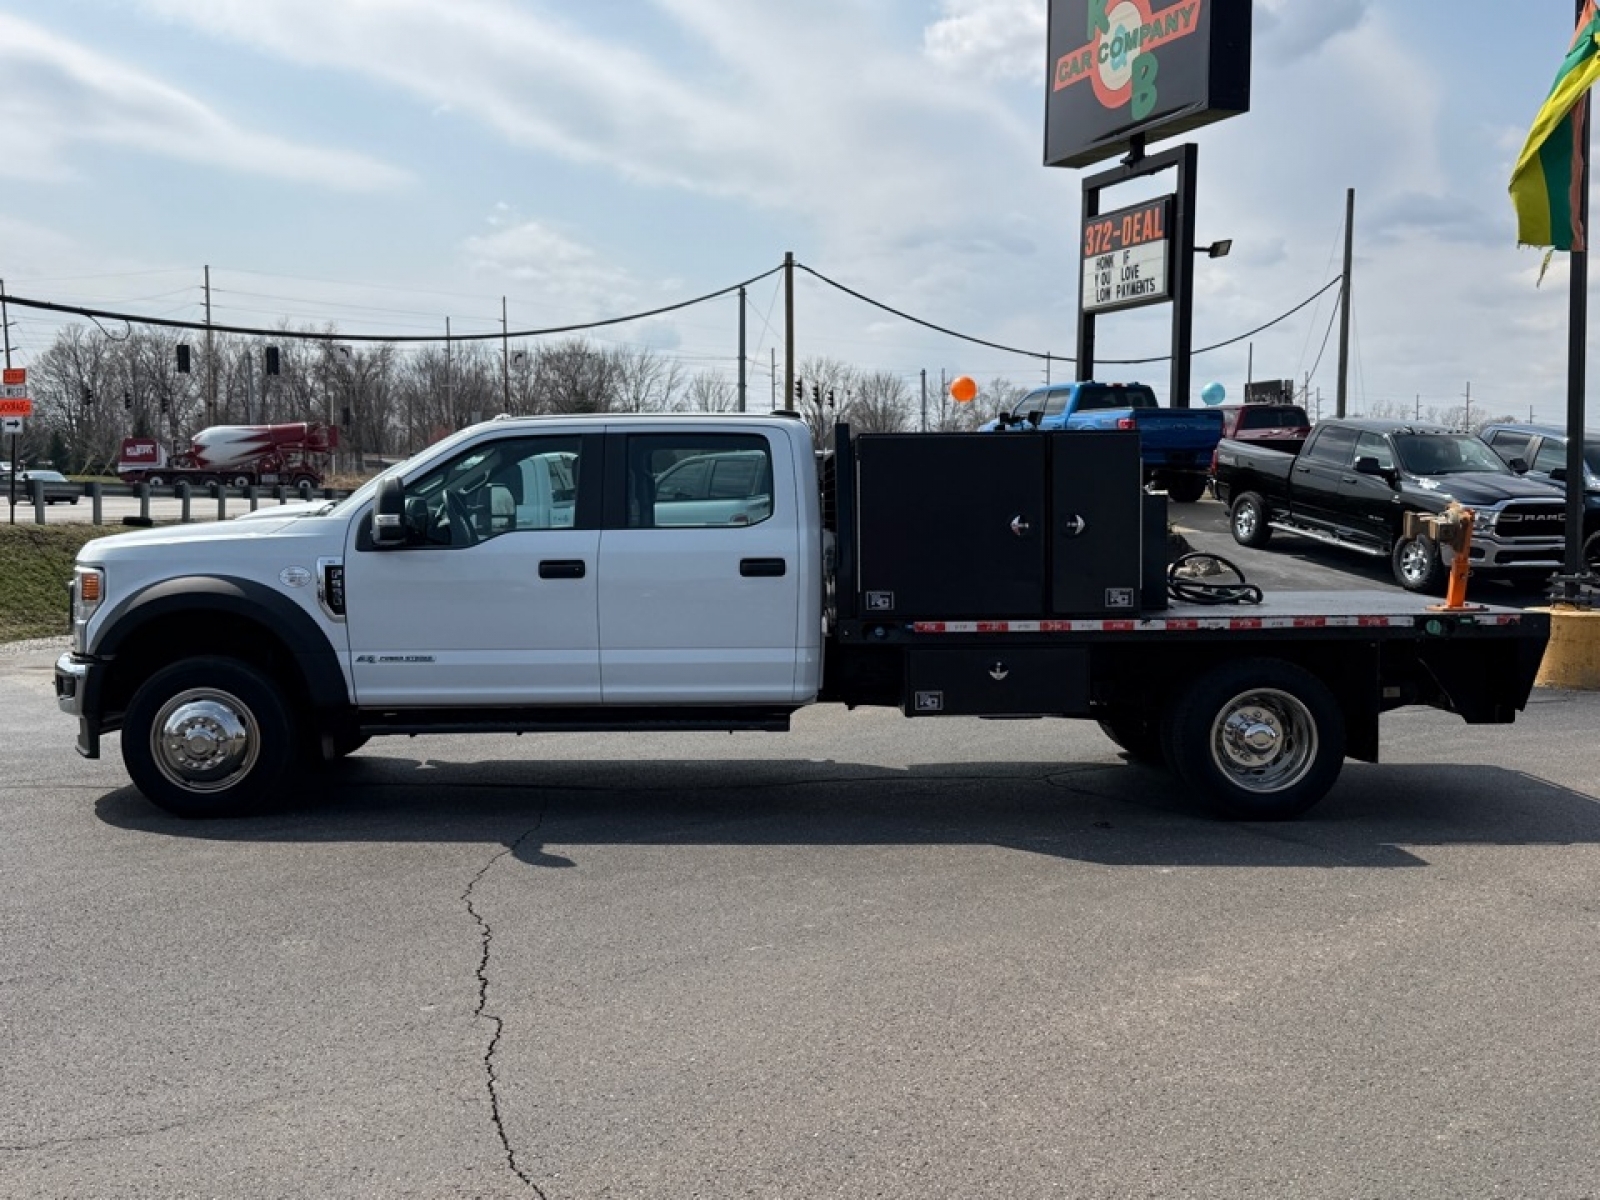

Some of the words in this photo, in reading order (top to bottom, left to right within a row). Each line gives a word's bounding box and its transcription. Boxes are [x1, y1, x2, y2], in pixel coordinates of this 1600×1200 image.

[1057, 51, 1093, 83] CAR
[1097, 2, 1197, 64] COMPANY
[1087, 0, 1110, 41] K
[1131, 52, 1159, 121] B
[1085, 206, 1164, 256] 372-DEAL
[1116, 277, 1155, 299] PAYMENTS
[1122, 264, 1139, 281] LOVE
